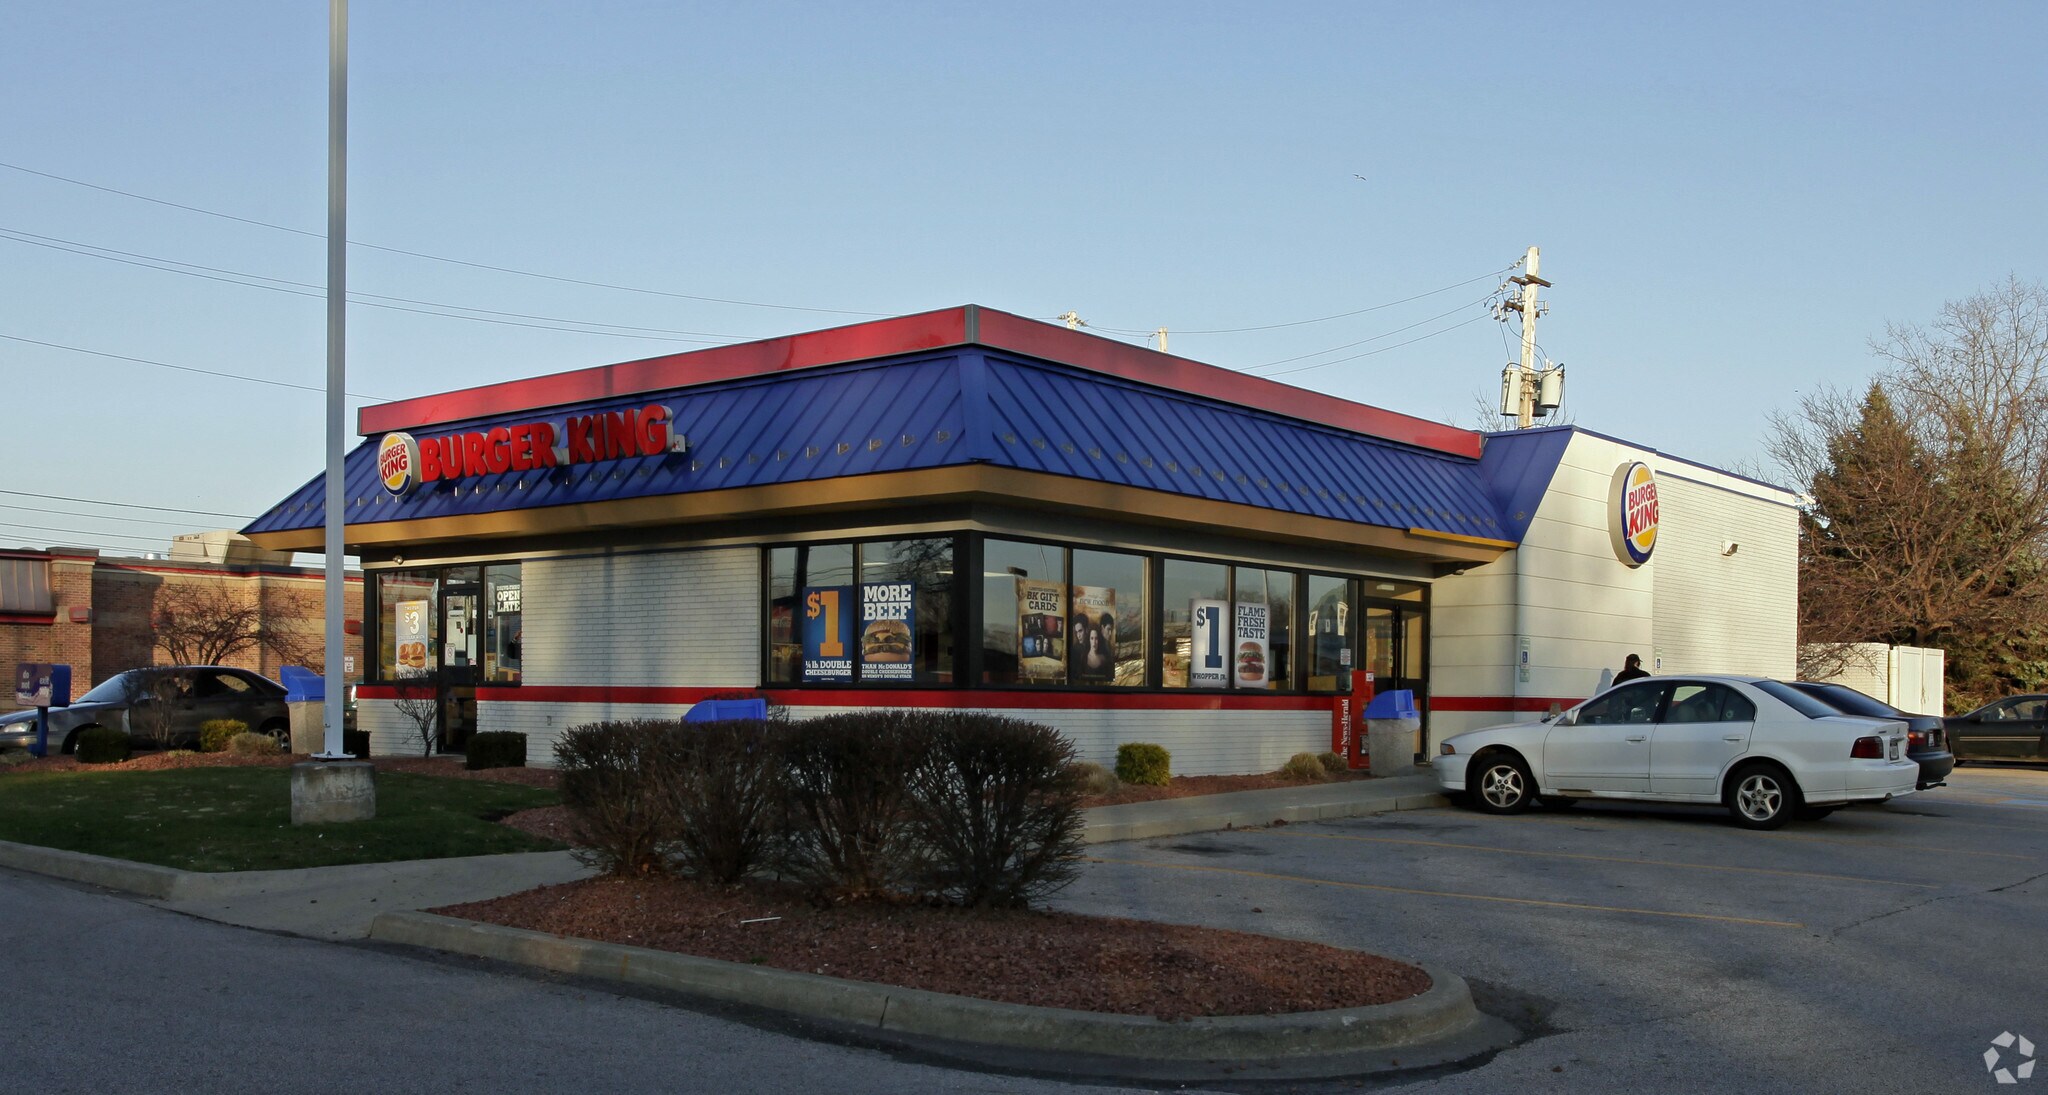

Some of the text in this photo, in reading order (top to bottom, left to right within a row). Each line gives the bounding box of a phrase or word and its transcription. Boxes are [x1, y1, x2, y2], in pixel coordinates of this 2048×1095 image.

[419, 404, 667, 483] BURGER KING
[380, 443, 406, 466] BURGER
[381, 454, 408, 483] KING
[1628, 500, 1659, 538] KING
[496, 590, 520, 601] OPEN
[863, 584, 912, 603] MORE
[1027, 591, 1059, 602] BK GIFT
[496, 600, 521, 612] LATE
[863, 602, 912, 621] BEEF
[1028, 601, 1057, 612] CARDS
[1238, 606, 1265, 617] FLAME
[404, 611, 420, 635] $3
[807, 591, 843, 657] $1
[1238, 616, 1265, 628] FRESH
[1197, 606, 1222, 668] $1
[1238, 627, 1265, 639] TASTE
[820, 660, 852, 669] DOUBLE
[22, 670, 29, 679] do
[1192, 672, 1219, 680] WHOPPER
[21, 681, 29, 689] not
[1341, 699, 1349, 745] News-Herald
